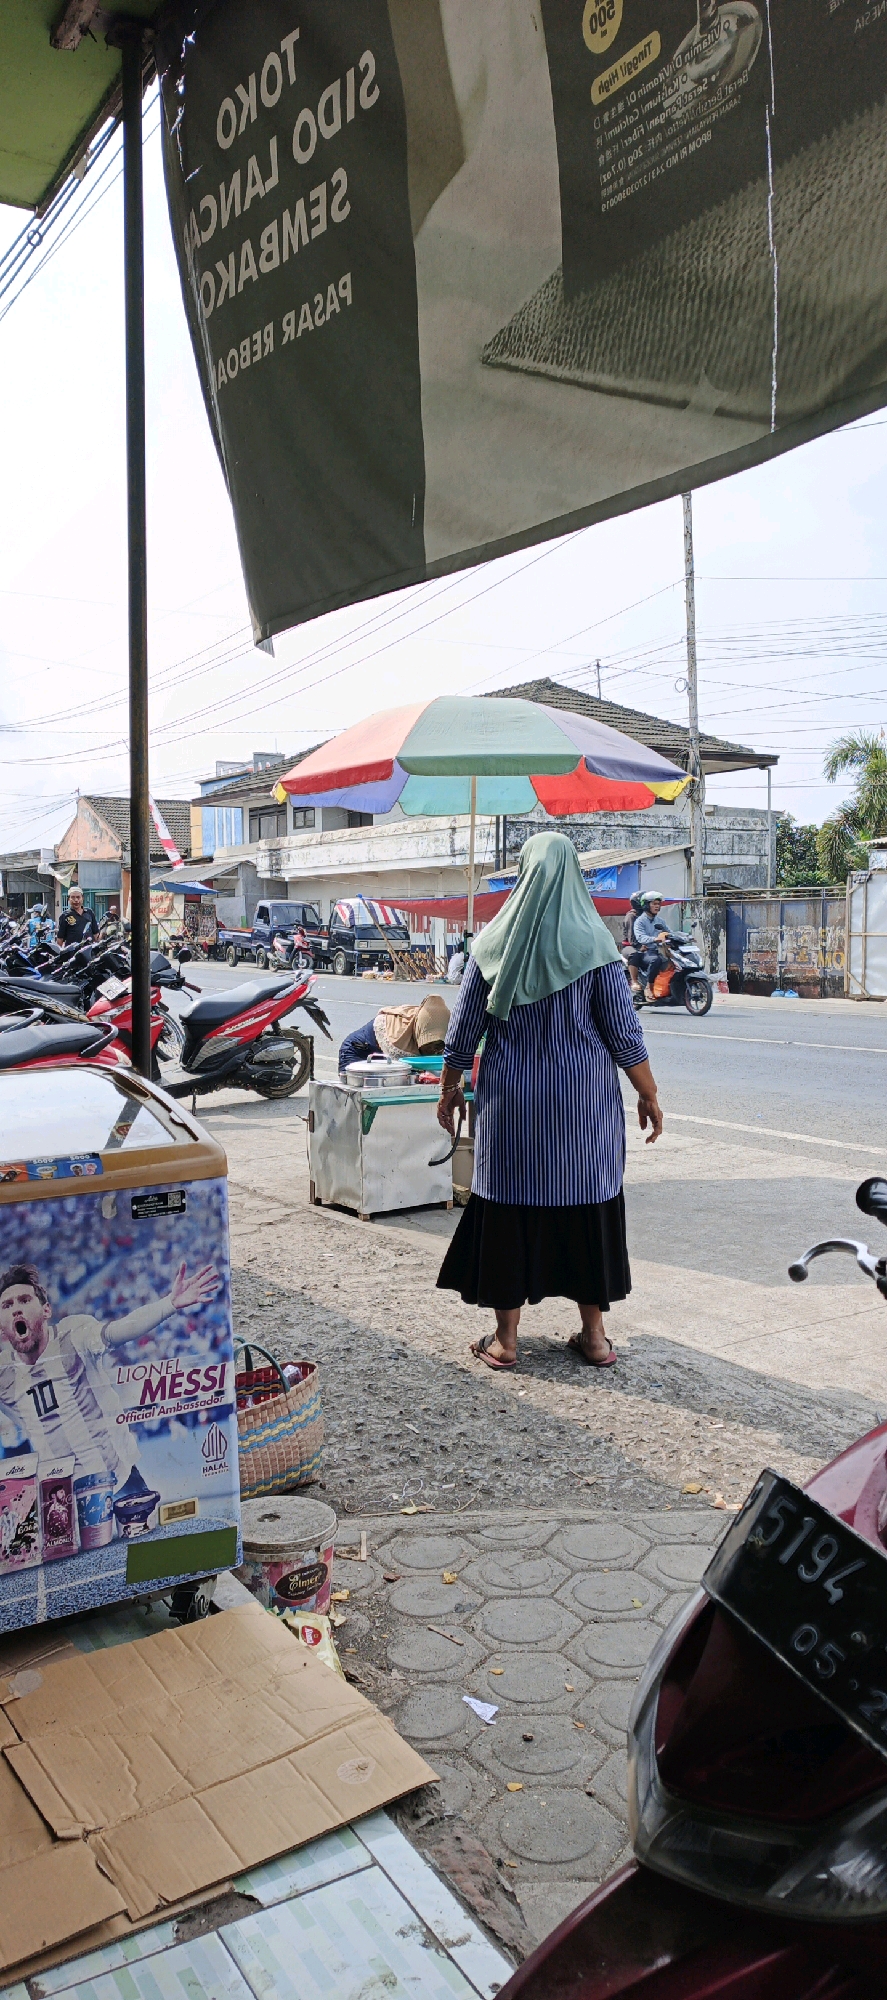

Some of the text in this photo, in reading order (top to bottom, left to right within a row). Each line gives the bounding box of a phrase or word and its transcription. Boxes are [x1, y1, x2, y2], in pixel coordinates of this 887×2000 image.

[116, 1358, 182, 1384] LIONEL
[139, 1363, 227, 1406] MESSI
[25, 1379, 59, 1418] 10
[116, 1394, 225, 1426] Official Ambassador
[202, 1462, 228, 1474] HALAL
[748, 1494, 868, 1606] 5194
